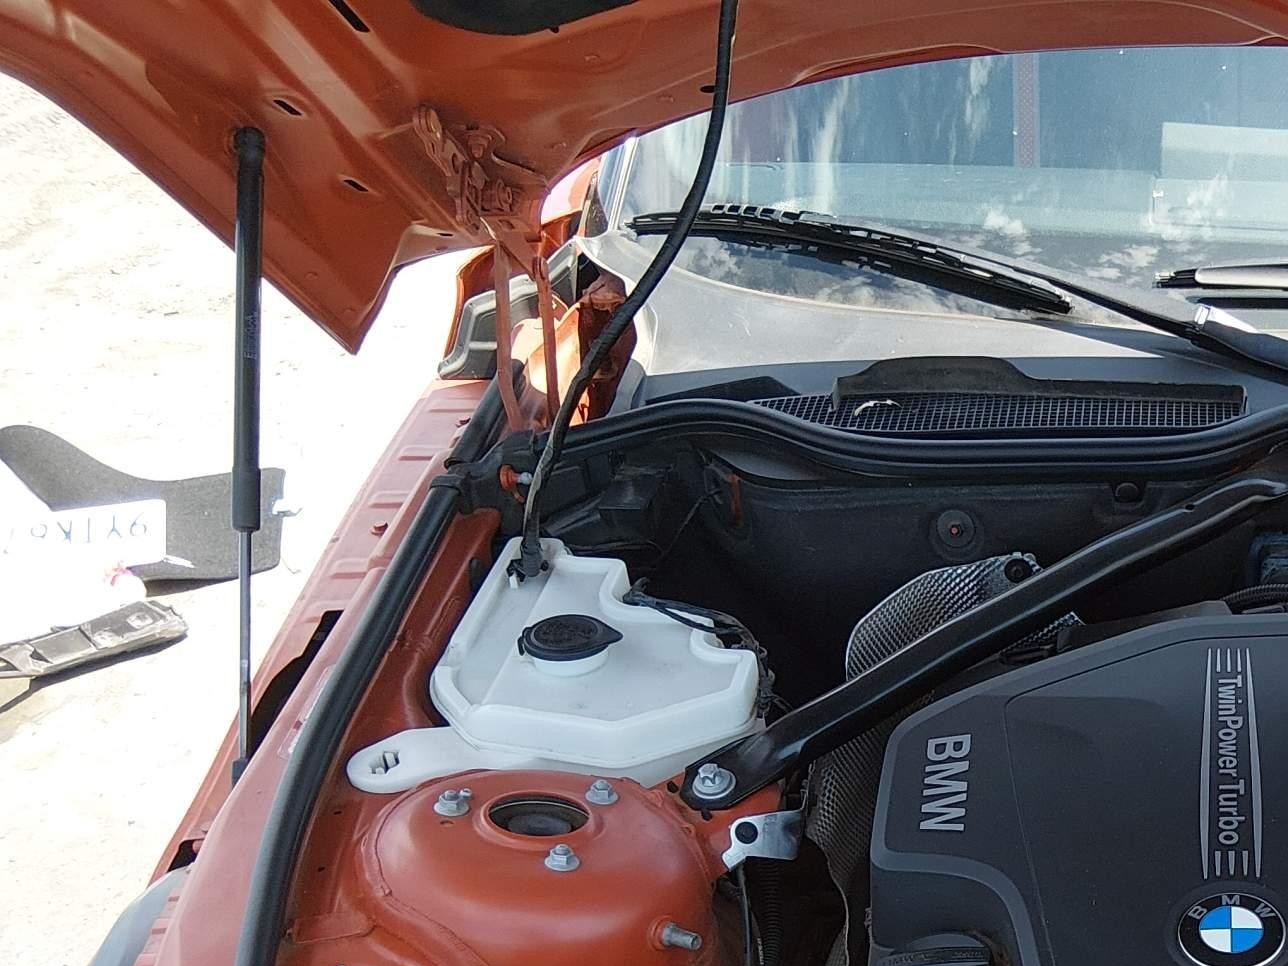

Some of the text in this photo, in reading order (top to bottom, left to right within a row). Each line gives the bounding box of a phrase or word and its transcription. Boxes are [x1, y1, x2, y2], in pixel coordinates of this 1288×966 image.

[919, 733, 972, 832] BMW
[1217, 674, 1246, 846] TwinPower Turbo
[1187, 894, 1276, 920] BMW
